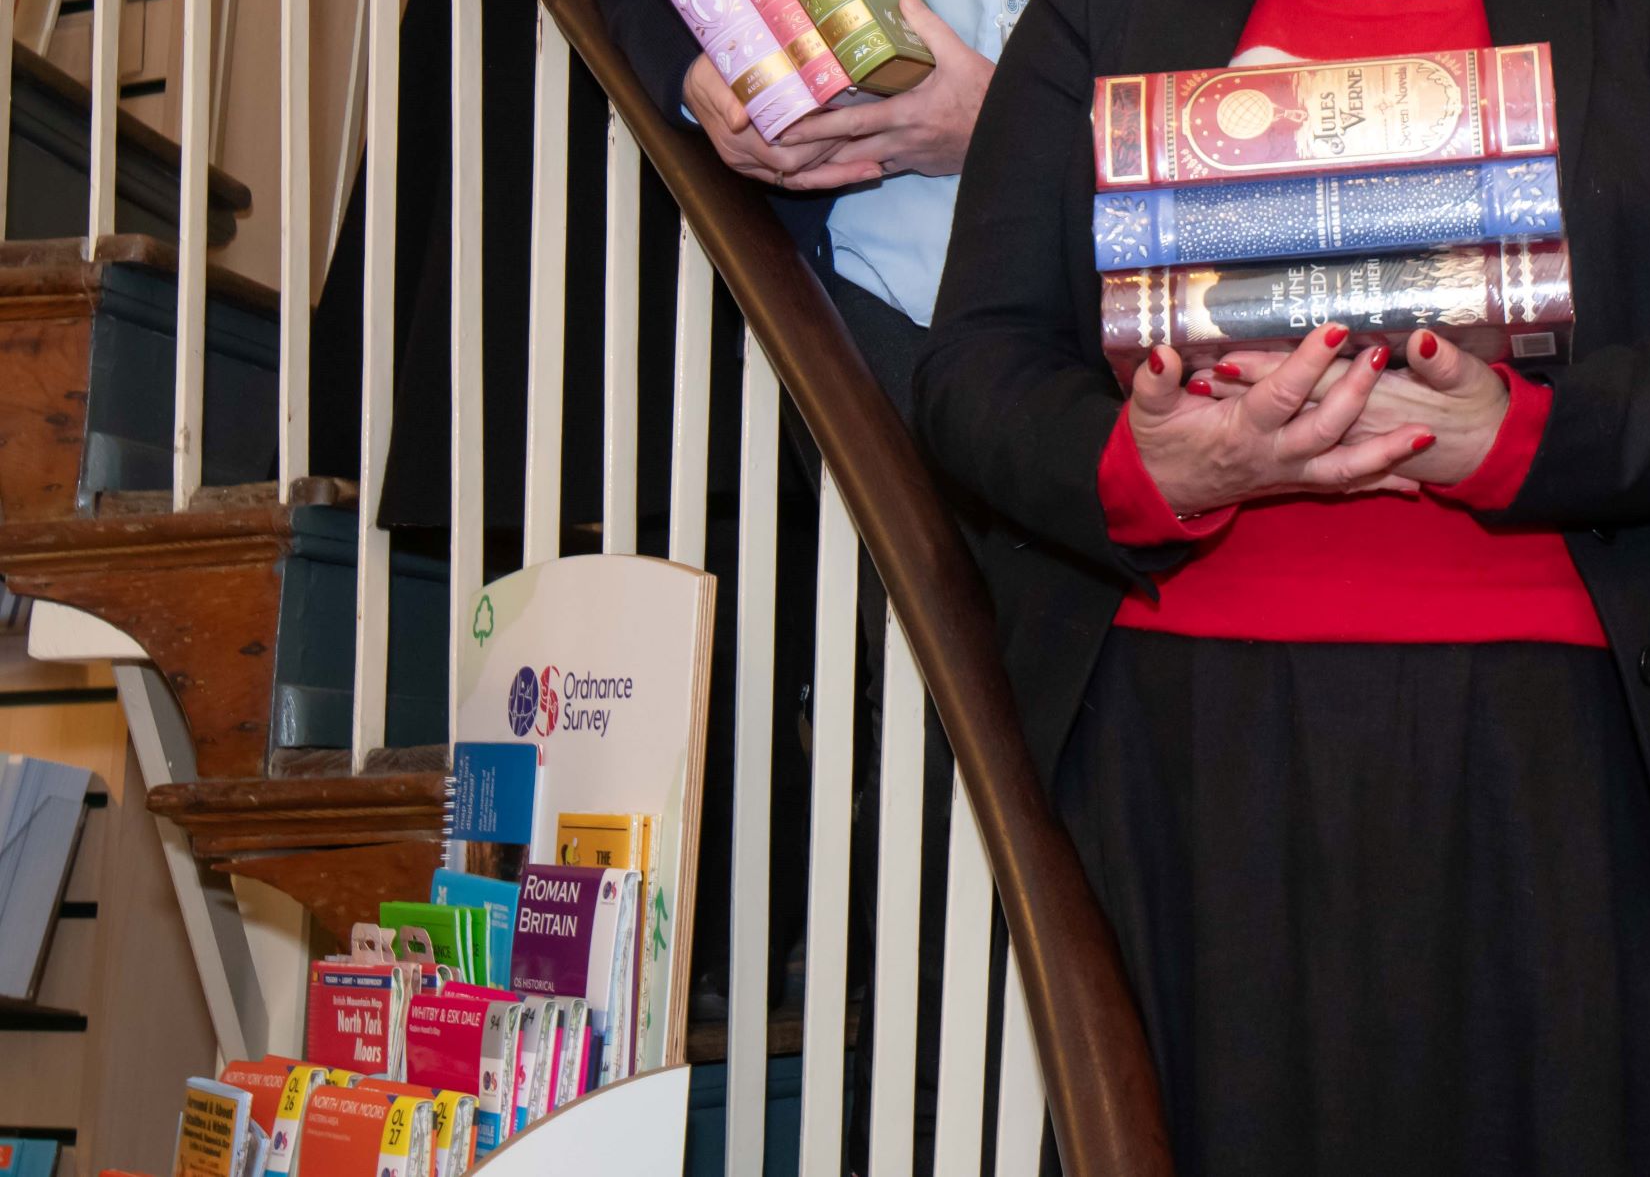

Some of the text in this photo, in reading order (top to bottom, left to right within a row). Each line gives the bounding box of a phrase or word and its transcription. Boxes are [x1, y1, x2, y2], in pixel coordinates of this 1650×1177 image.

[1343, 68, 1365, 134] VERNE
[1315, 92, 1346, 153] JULES
[1271, 282, 1284, 311] THE
[1288, 266, 1306, 328] DIVINE
[1311, 264, 1329, 328] COMEDY
[562, 671, 633, 737] Ordnance Survey
[523, 875, 580, 904] ROMAN
[519, 907, 577, 937] BRITAIN
[522, 980, 555, 992] HISTORICAL
[337, 1010, 362, 1033] North
[365, 1011, 382, 1036] York
[412, 1006, 481, 1027] WHITBY & ESK DALE
[354, 1038, 381, 1063] Moors
[289, 1078, 299, 1093] OL
[285, 1096, 294, 1111] 26
[312, 1095, 386, 1118] NORTH YORK MOORS
[392, 1109, 404, 1126] OL
[389, 1129, 401, 1145] 27
